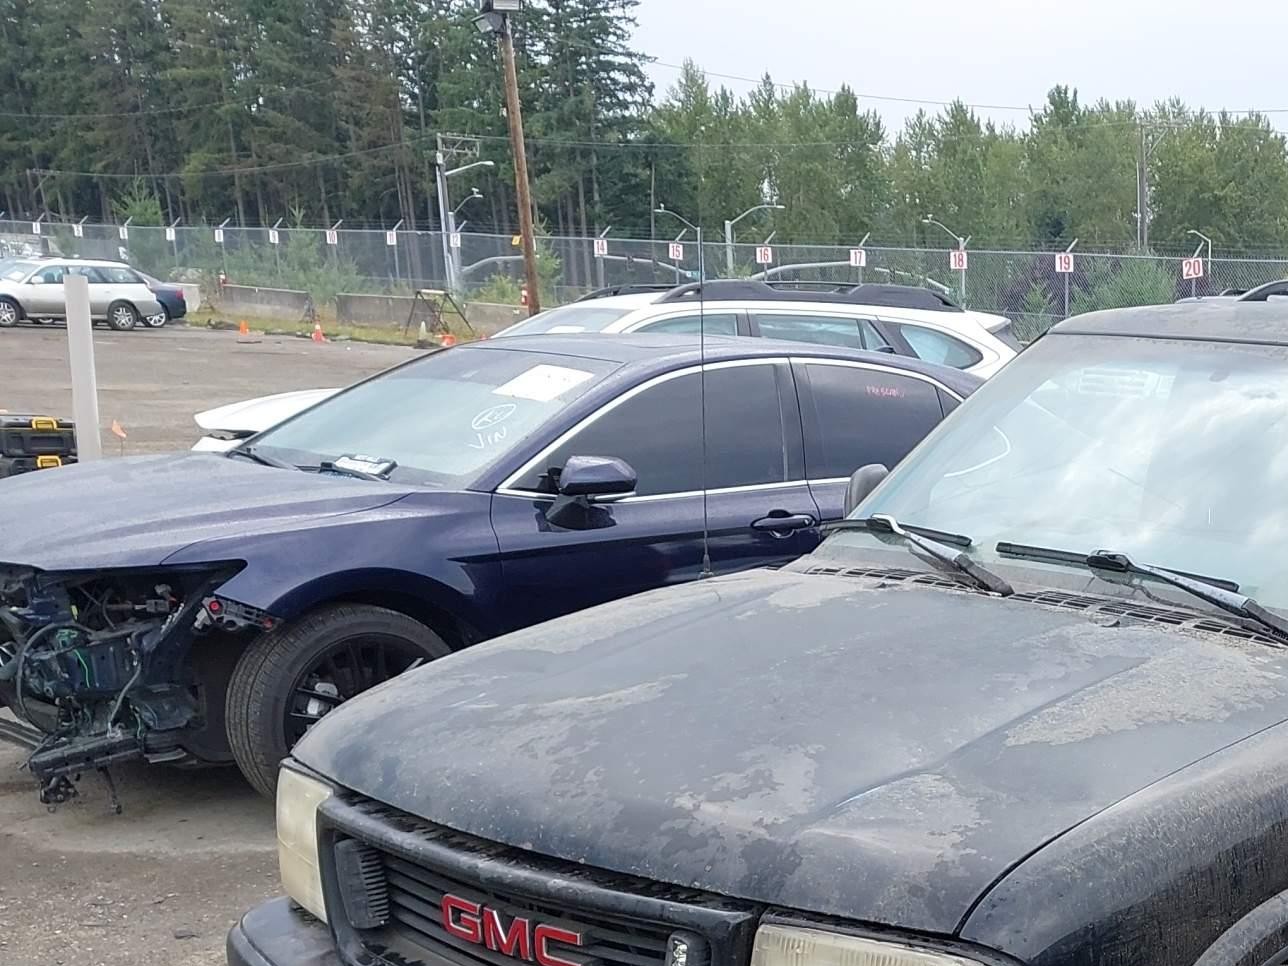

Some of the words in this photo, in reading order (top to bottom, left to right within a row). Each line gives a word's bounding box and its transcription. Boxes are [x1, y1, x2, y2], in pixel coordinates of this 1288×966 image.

[596, 240, 605, 255] 14
[671, 245, 681, 258] 15
[759, 249, 769, 262] 16
[853, 252, 863, 265] 17
[953, 254, 964, 268] 18
[1058, 255, 1071, 271] 19
[1184, 260, 1201, 277] 20
[467, 426, 507, 449] VIN
